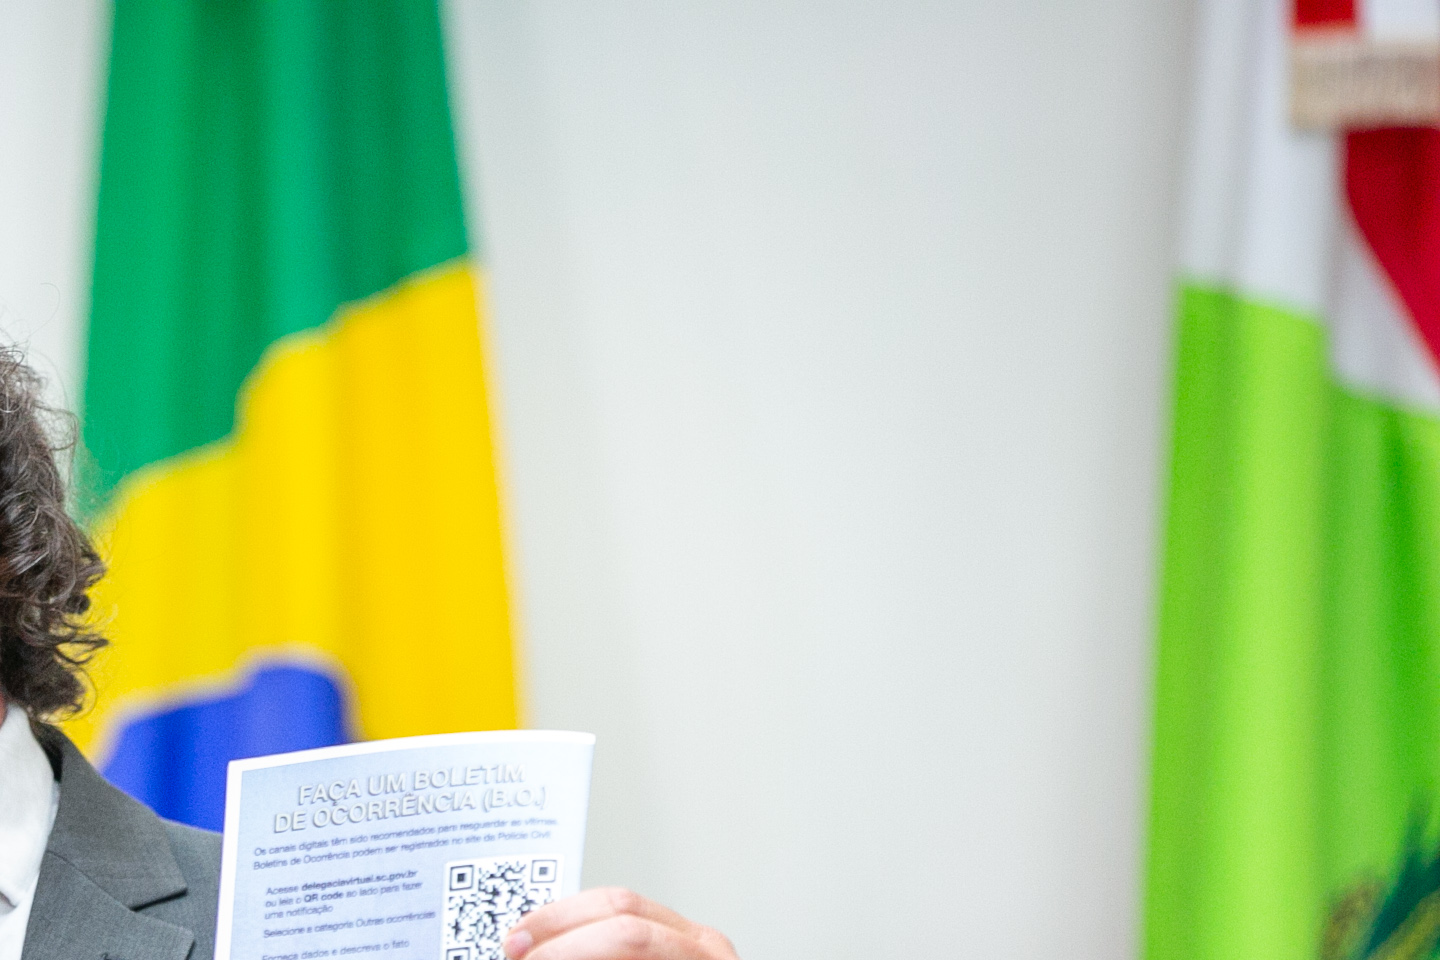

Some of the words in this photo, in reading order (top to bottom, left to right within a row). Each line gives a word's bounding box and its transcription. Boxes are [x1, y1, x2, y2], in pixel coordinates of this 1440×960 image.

[298, 779, 362, 806] FAÇA
[368, 773, 407, 796] UM
[413, 764, 527, 791] BOLETIM
[274, 810, 307, 834] DE
[312, 790, 477, 828] OCORRÊNCIA
[483, 786, 549, 814] (B.O.)
[253, 856, 289, 871] Boletins
[290, 856, 302, 867] de
[303, 851, 351, 865] Ocorrência
[352, 847, 383, 860] podem
[385, 845, 399, 855] ser
[400, 839, 449, 853] registrados
[451, 836, 464, 846] no
[465, 835, 482, 844] site
[483, 832, 496, 842] da
[497, 830, 528, 841] Polícia
[254, 848, 267, 857] Os
[268, 844, 297, 855] canais
[298, 840, 329, 852] digitais
[331, 836, 348, 847] têm
[349, 835, 369, 844] sido
[370, 826, 436, 841] recomendados
[438, 824, 458, 834] para
[460, 820, 508, 832] resguardar
[265, 884, 299, 897] Acesse
[301, 869, 419, 892] delegaciavirtual.sc.gov.br
[265, 899, 277, 908] ou
[278, 896, 294, 907] leia
[295, 897, 303, 905] o
[303, 893, 320, 904] QR
[320, 891, 345, 902] code
[346, 889, 358, 899] ao
[359, 886, 379, 897] lado
[380, 884, 401, 896] para
[402, 880, 423, 892] fazer
[263, 926, 306, 939] Selecione
[306, 926, 313, 934] a
[314, 919, 354, 933] categoria
[355, 915, 386, 928] Outras
[386, 910, 436, 925] ocorrências
[264, 910, 284, 921] uma
[285, 904, 334, 918] notificação
[301, 949, 330, 960] dados
[331, 948, 338, 957] e
[339, 944, 381, 956] descreva
[382, 942, 390, 951] o
[391, 938, 411, 950] fato
